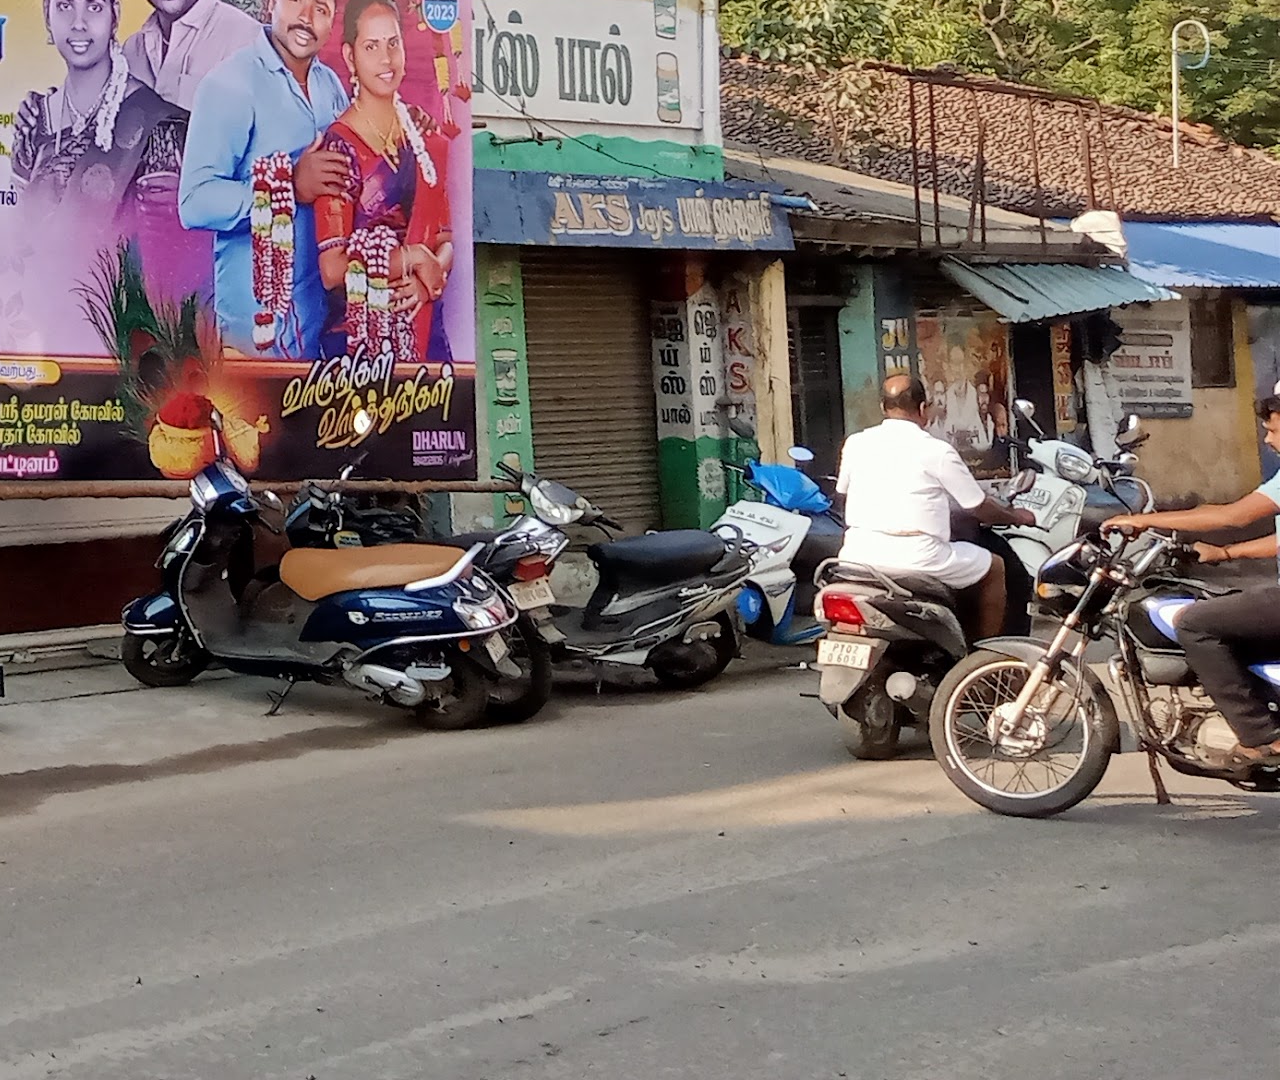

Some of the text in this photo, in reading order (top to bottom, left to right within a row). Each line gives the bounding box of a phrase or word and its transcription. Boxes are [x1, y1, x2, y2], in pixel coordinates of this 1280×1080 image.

[427, 4, 456, 22] 2023
[555, 24, 632, 106] பால்
[551, 192, 634, 236] AKS
[21, 396, 68, 423] குமரன்
[70, 399, 125, 422] கோவில்
[26, 422, 82, 445] கோவில்
[412, 431, 465, 450] DHARUN
